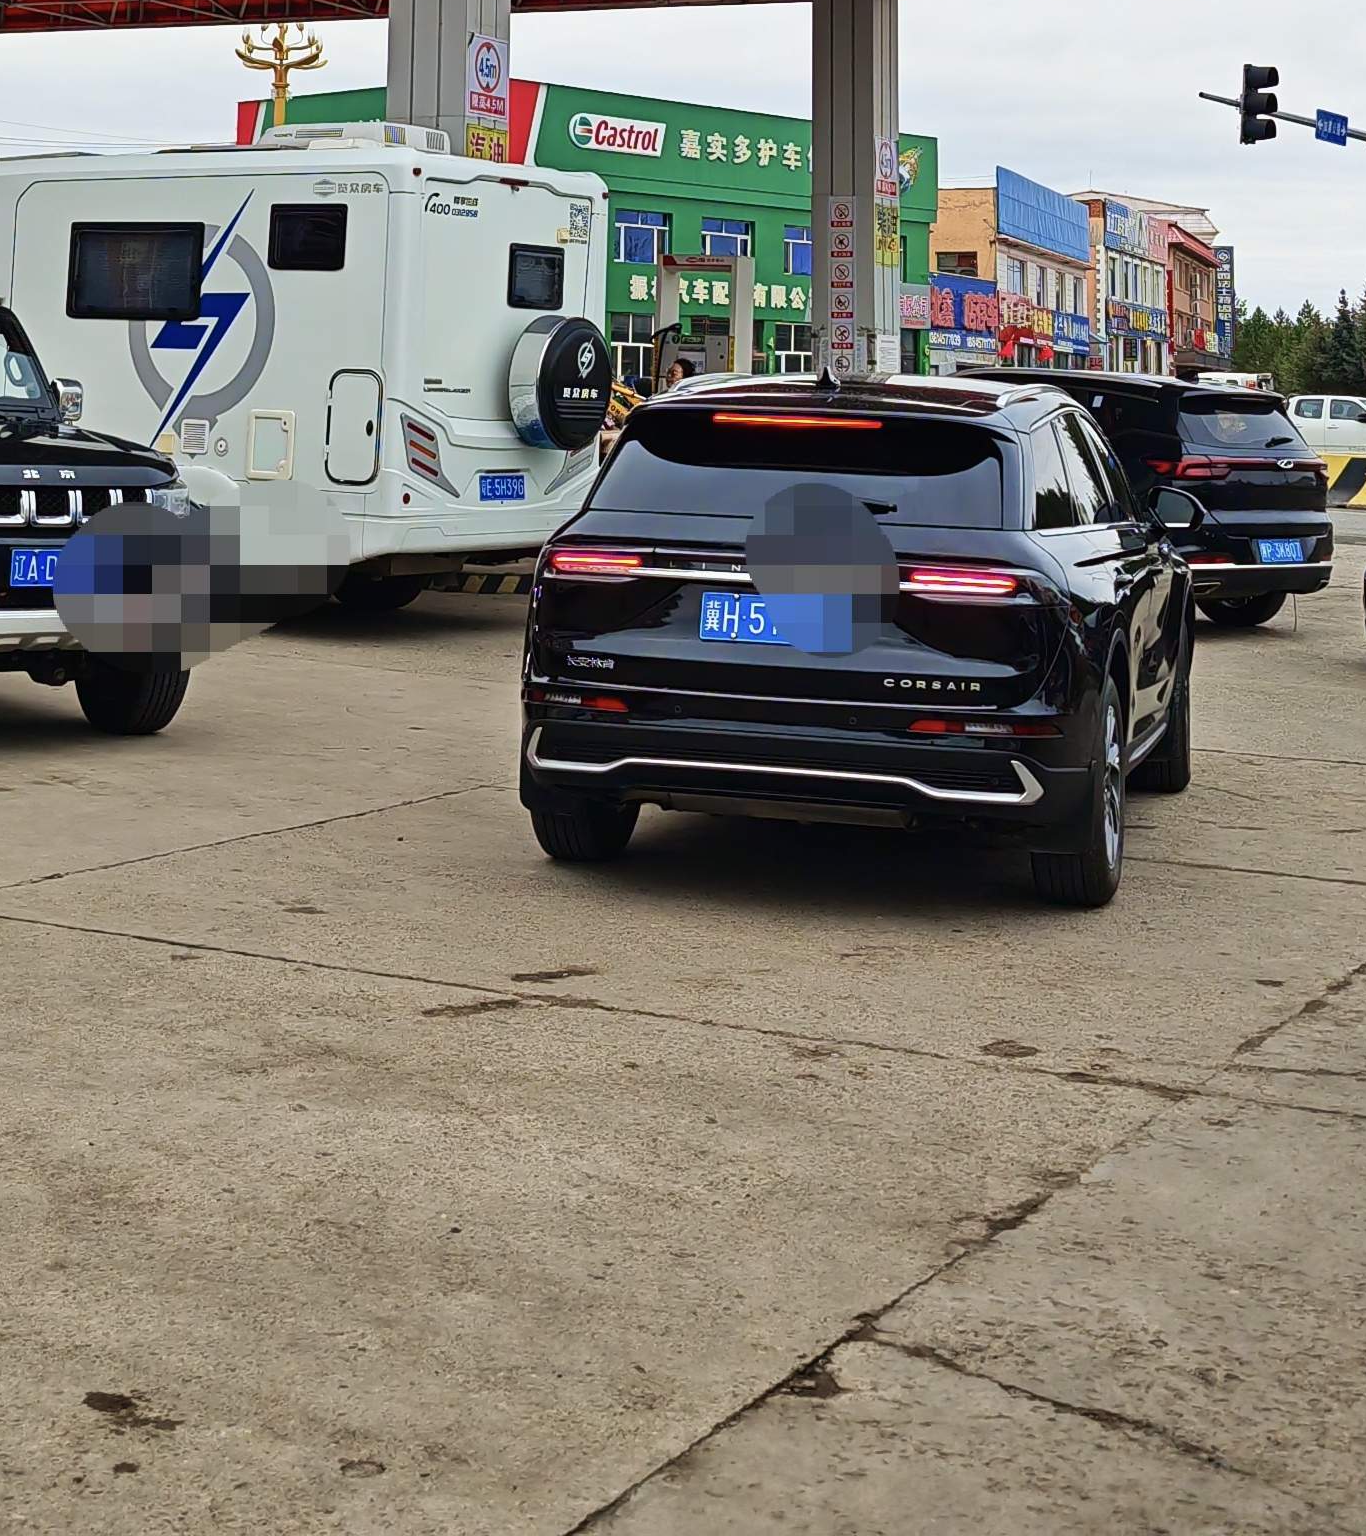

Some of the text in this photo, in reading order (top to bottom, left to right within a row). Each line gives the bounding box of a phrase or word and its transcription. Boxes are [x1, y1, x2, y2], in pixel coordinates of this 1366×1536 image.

[595, 119, 659, 152] Castrol
[680, 129, 812, 171] 嘉实多护车
[430, 203, 451, 216] 400
[704, 600, 777, 636] 冀H·5
[882, 678, 981, 692] CORSAIR
